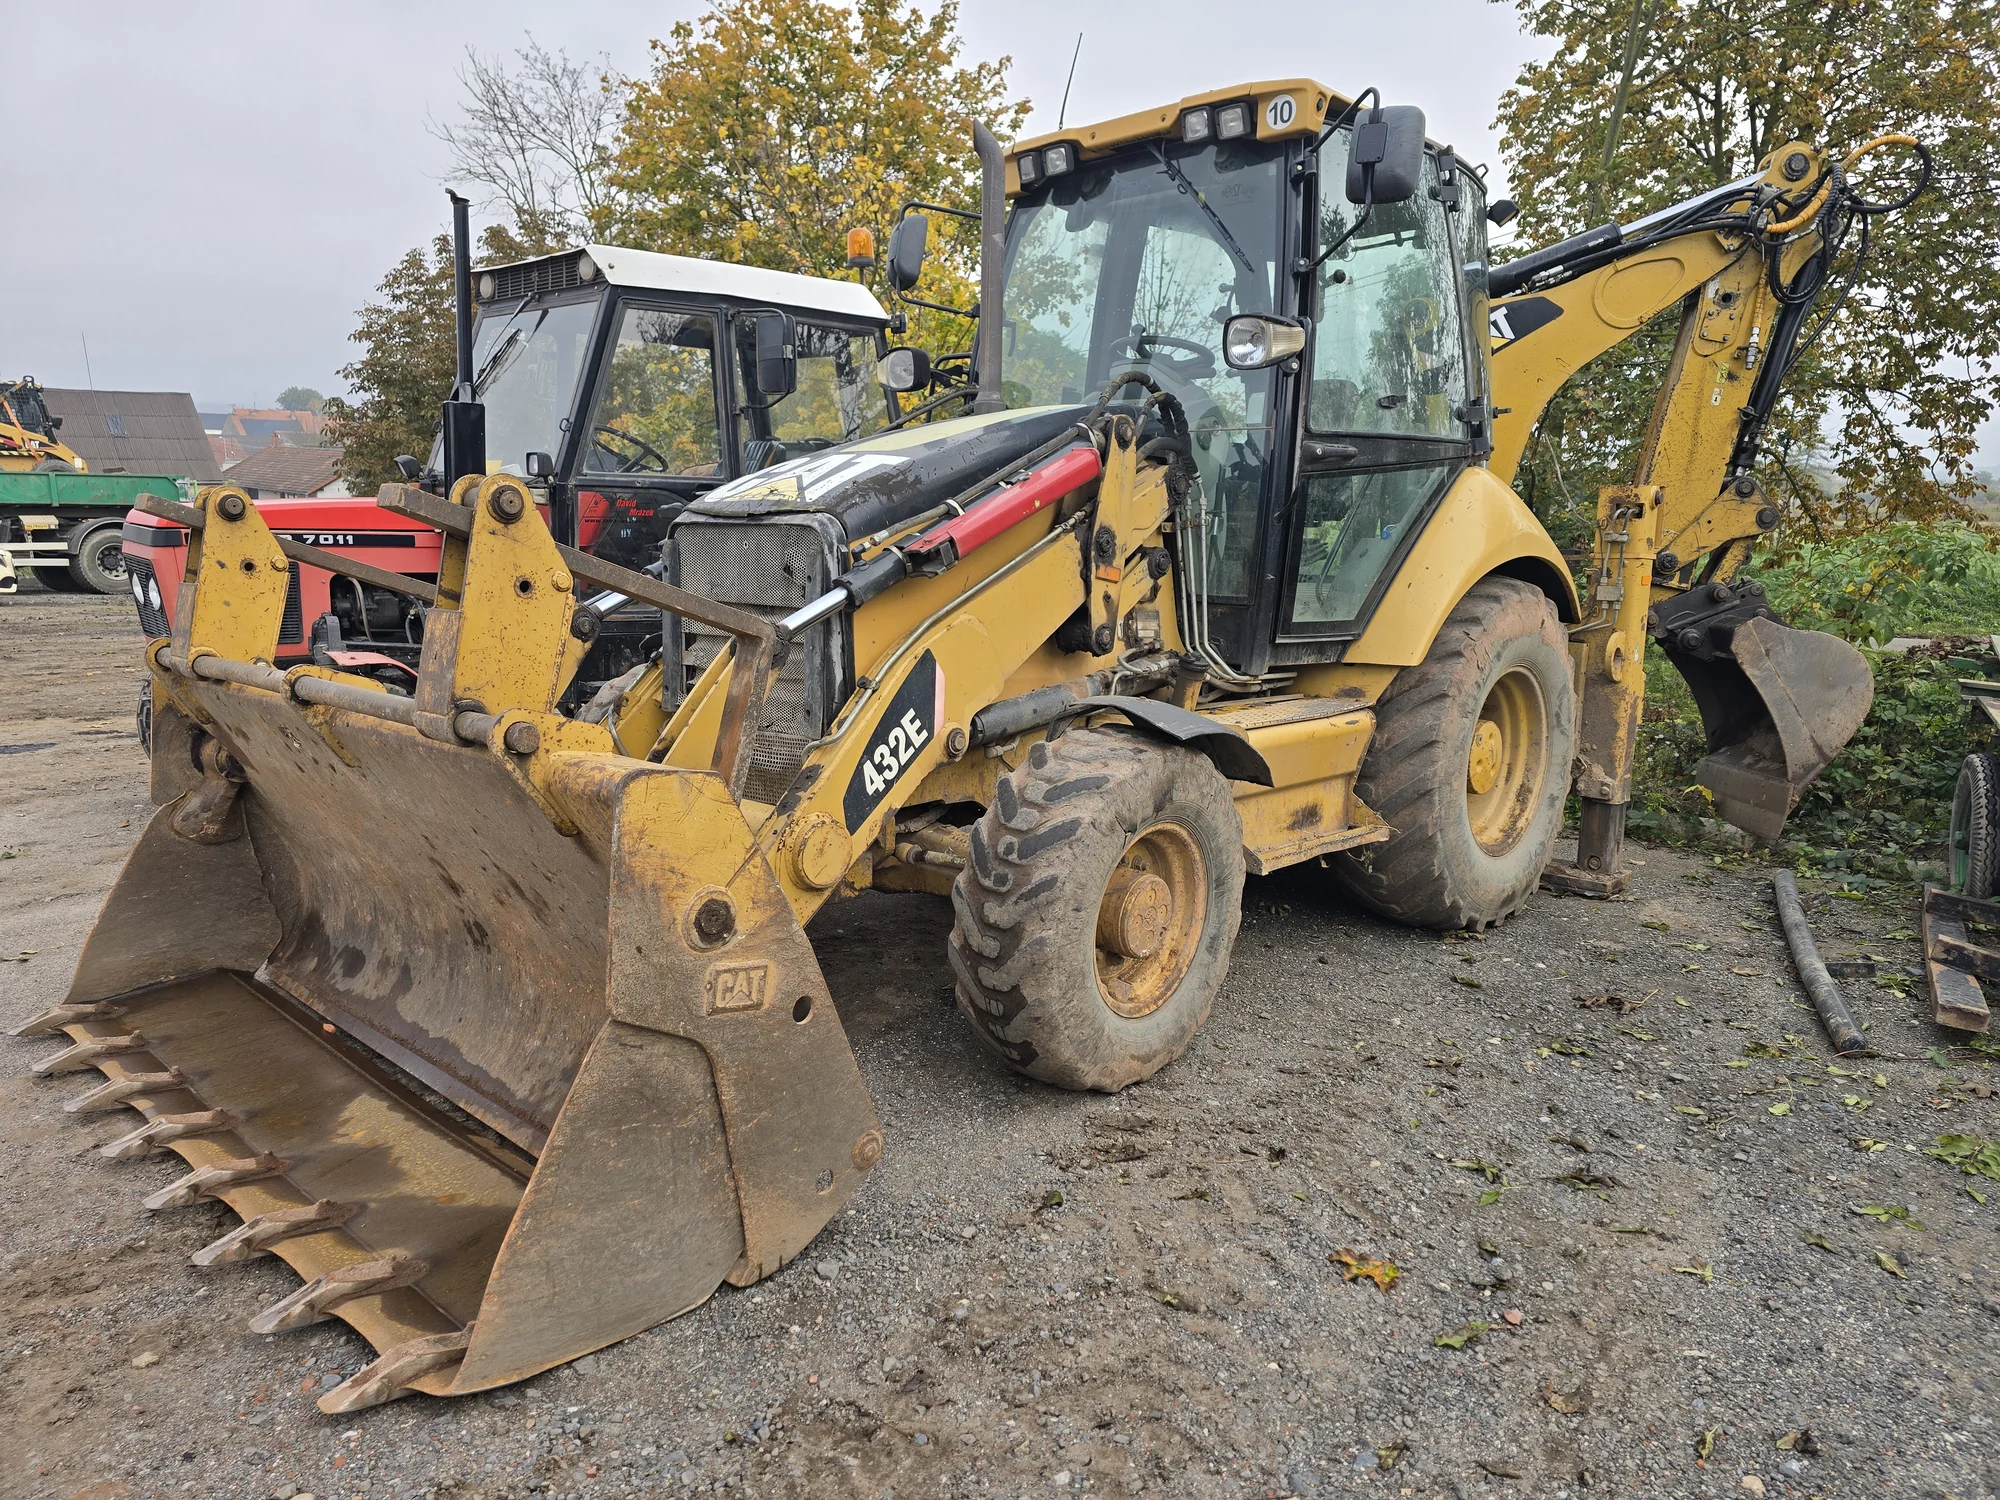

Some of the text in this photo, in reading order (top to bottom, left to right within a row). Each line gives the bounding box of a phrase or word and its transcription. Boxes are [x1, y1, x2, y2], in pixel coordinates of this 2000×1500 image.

[1268, 100, 1293, 126] 10
[704, 453, 912, 503] CAT
[302, 534, 354, 545] 7011
[862, 707, 929, 796] 432E
[716, 968, 767, 1008] CAT
